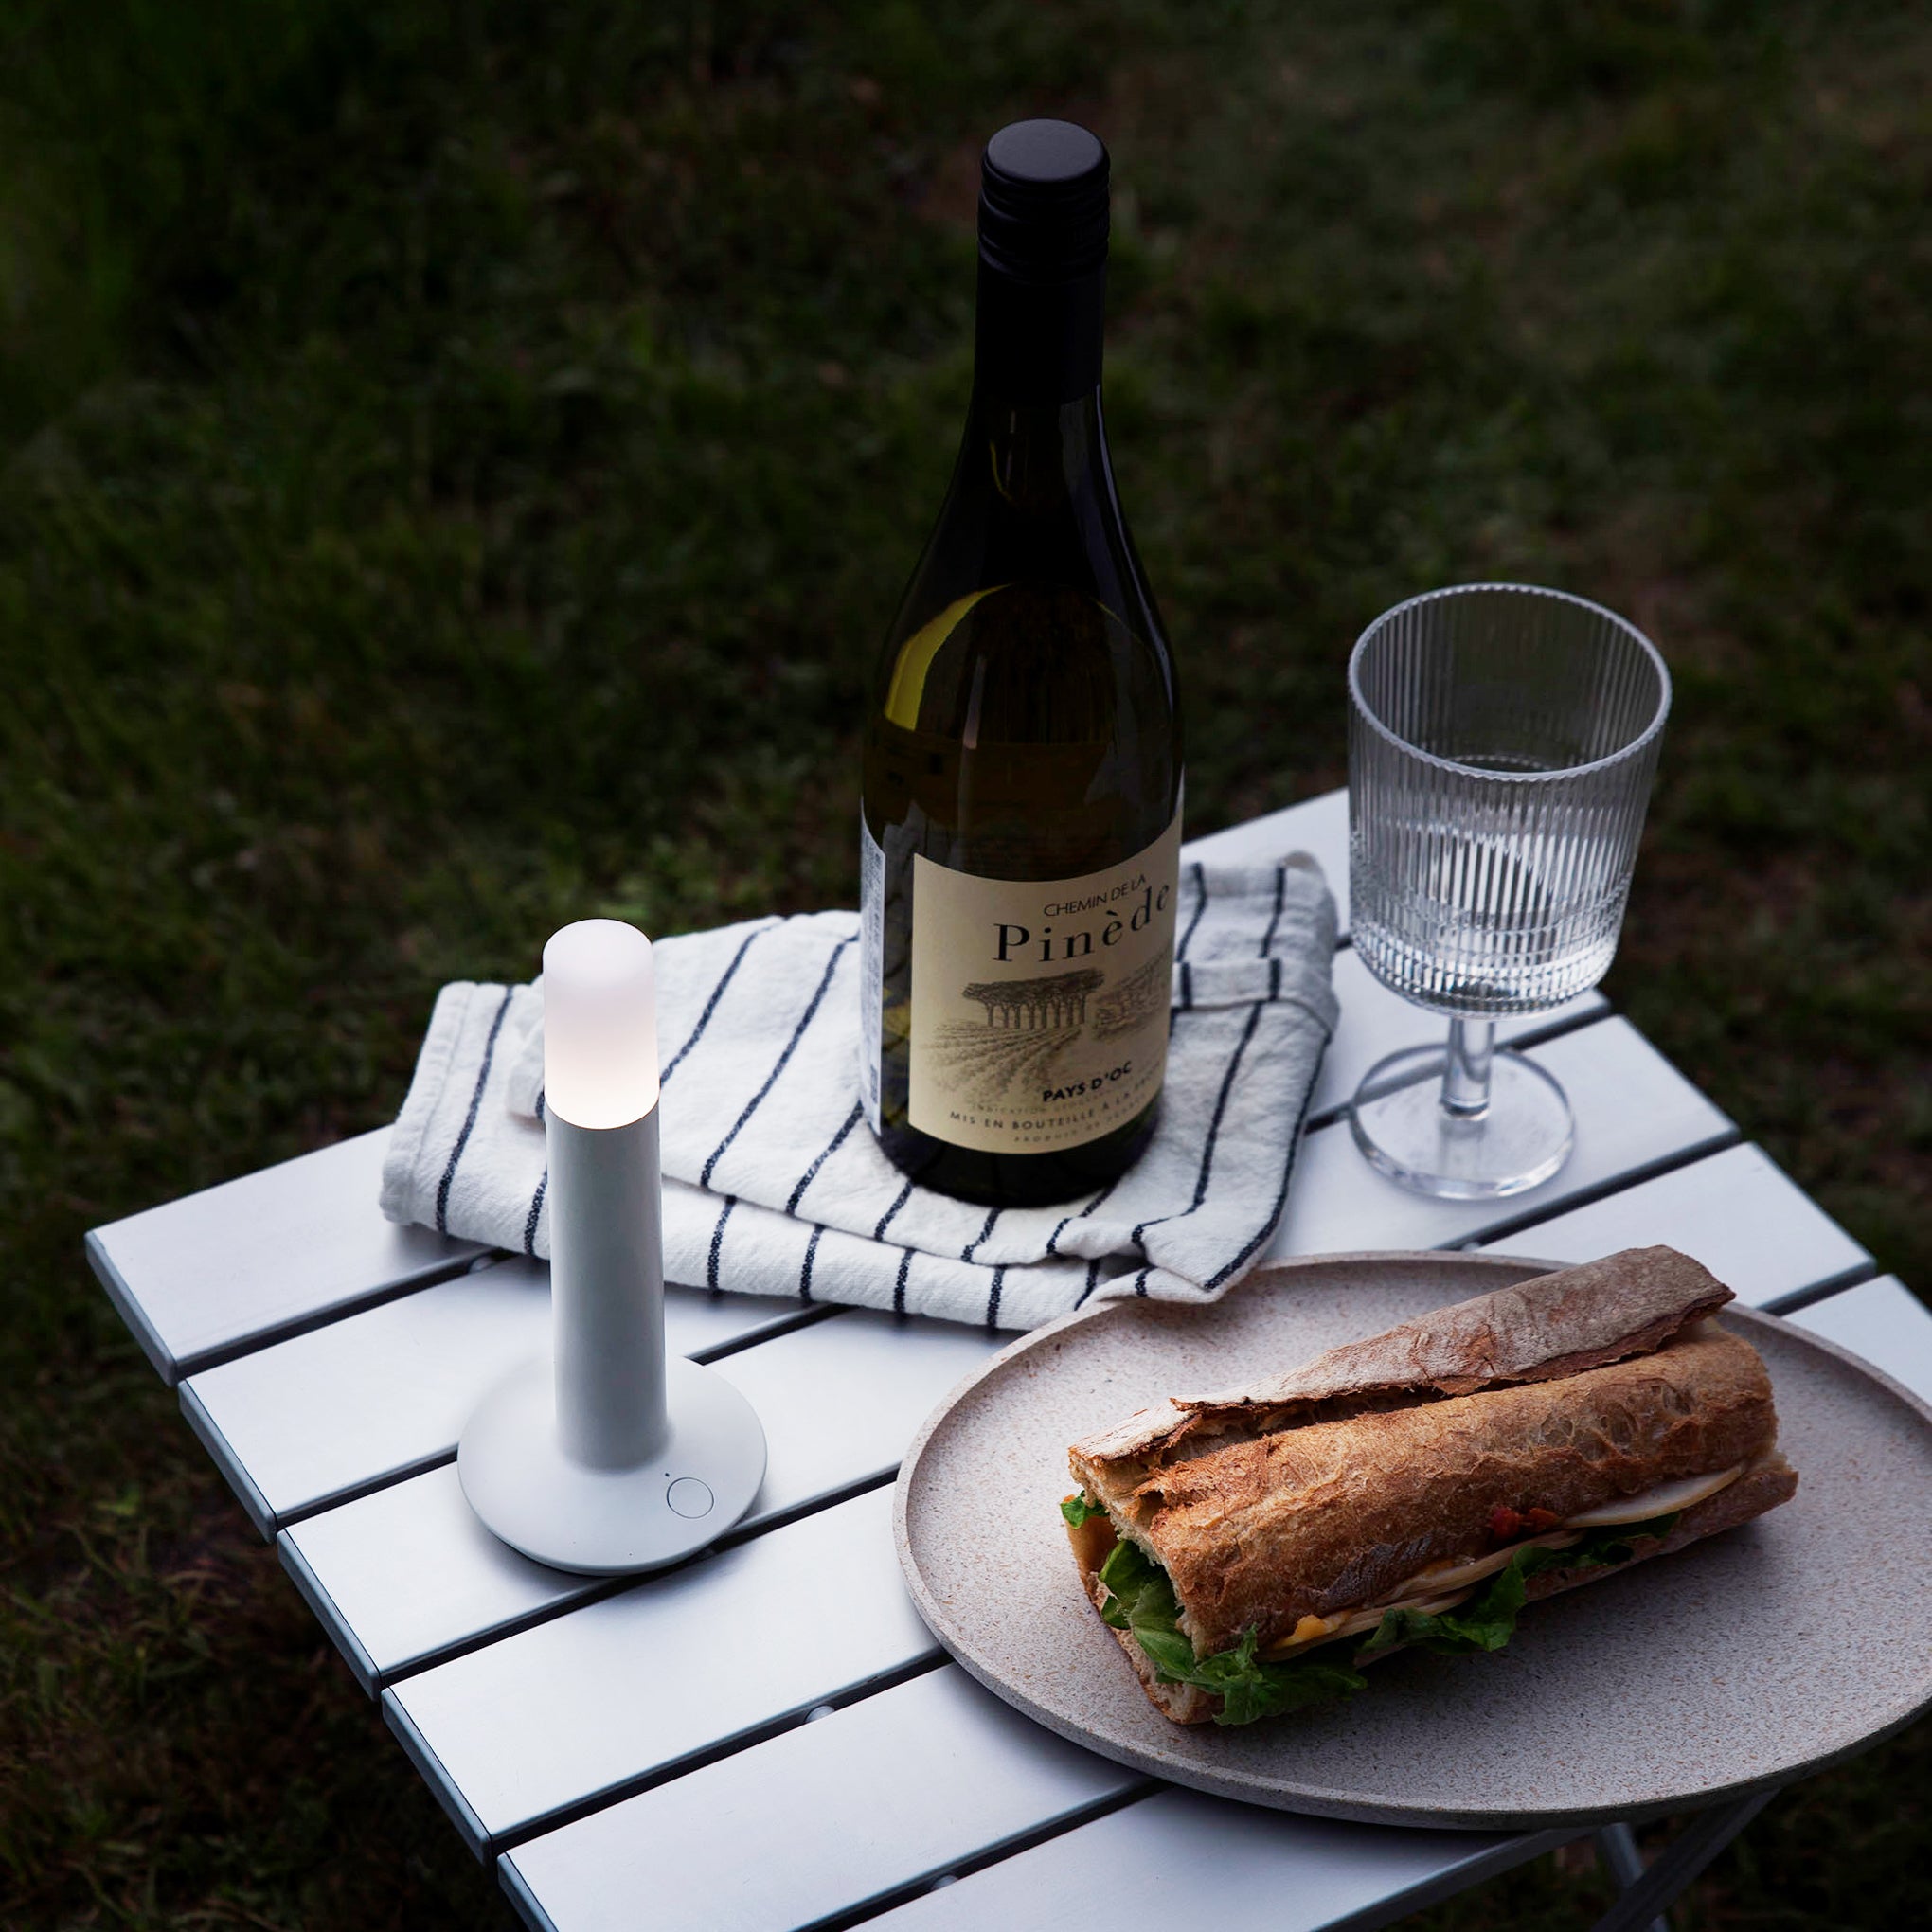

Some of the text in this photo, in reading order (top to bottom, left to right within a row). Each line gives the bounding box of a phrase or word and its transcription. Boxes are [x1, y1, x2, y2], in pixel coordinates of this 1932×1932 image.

[1043, 873, 1148, 917] CHEMIN DE LA
[993, 884, 1171, 962] Pinède
[1042, 1082, 1086, 1103] PAYS
[1089, 1059, 1134, 1090] D'OC
[950, 1110, 975, 1125] MIS
[984, 1118, 1004, 1129] EN
